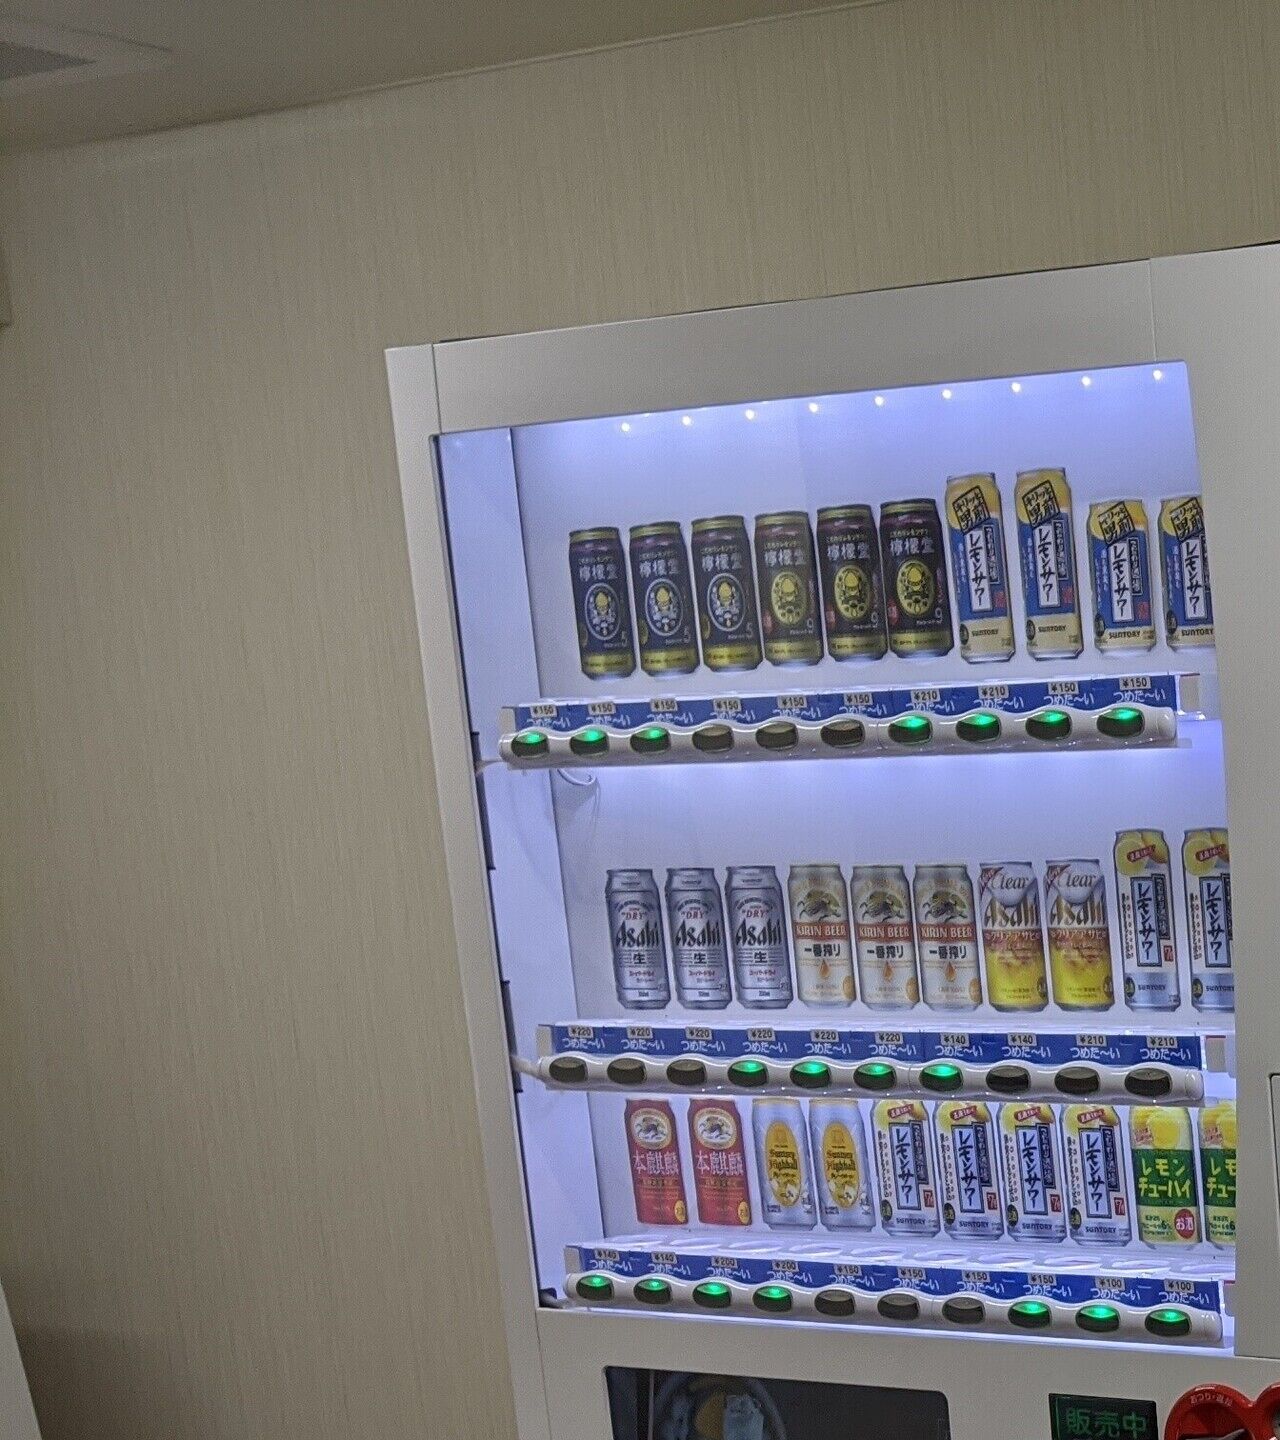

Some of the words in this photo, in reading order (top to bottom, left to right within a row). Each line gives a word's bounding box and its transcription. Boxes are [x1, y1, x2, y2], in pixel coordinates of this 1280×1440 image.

[1142, 1158, 1185, 1176] レモン
[1139, 1177, 1191, 1198] チューハイ
[1065, 1411, 1148, 1440] 販売中
